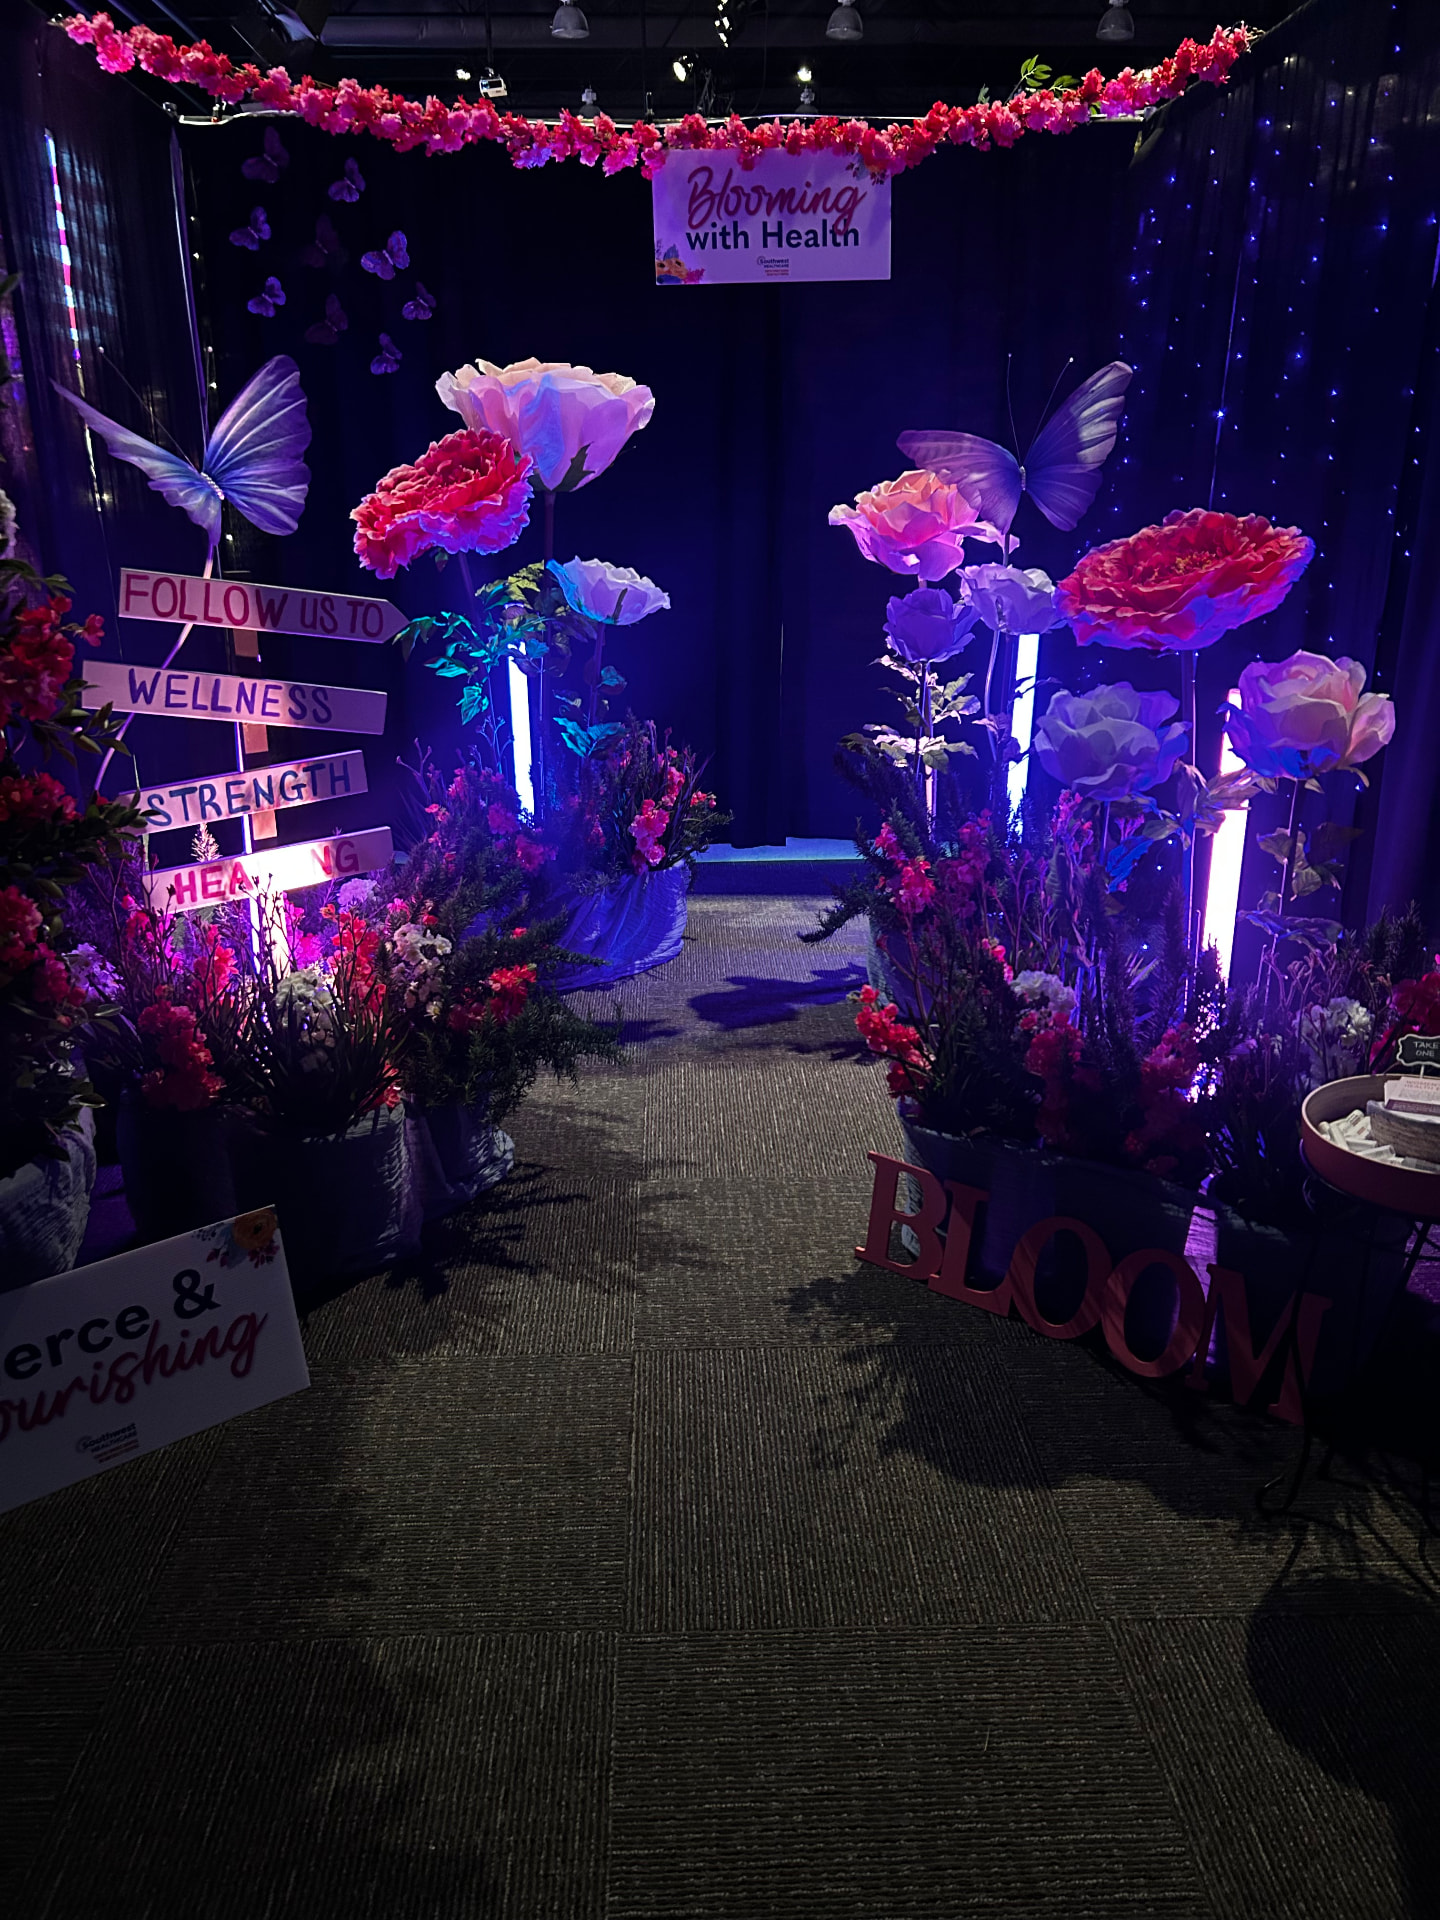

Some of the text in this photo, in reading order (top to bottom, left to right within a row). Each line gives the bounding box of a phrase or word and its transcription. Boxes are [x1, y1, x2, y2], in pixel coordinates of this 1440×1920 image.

[687, 165, 867, 236] Blooming
[686, 218, 860, 250] with Health
[124, 574, 384, 637] FOLLOW US TO
[128, 667, 333, 724] WELLNESS
[145, 759, 351, 826] STRENGTH
[173, 839, 360, 905] HEANG
[1412, 1040, 1440, 1050] TAKE
[1415, 1049, 1435, 1057] ONE
[172, 1269, 222, 1319] &
[853, 1149, 1336, 1427] BLOOM
